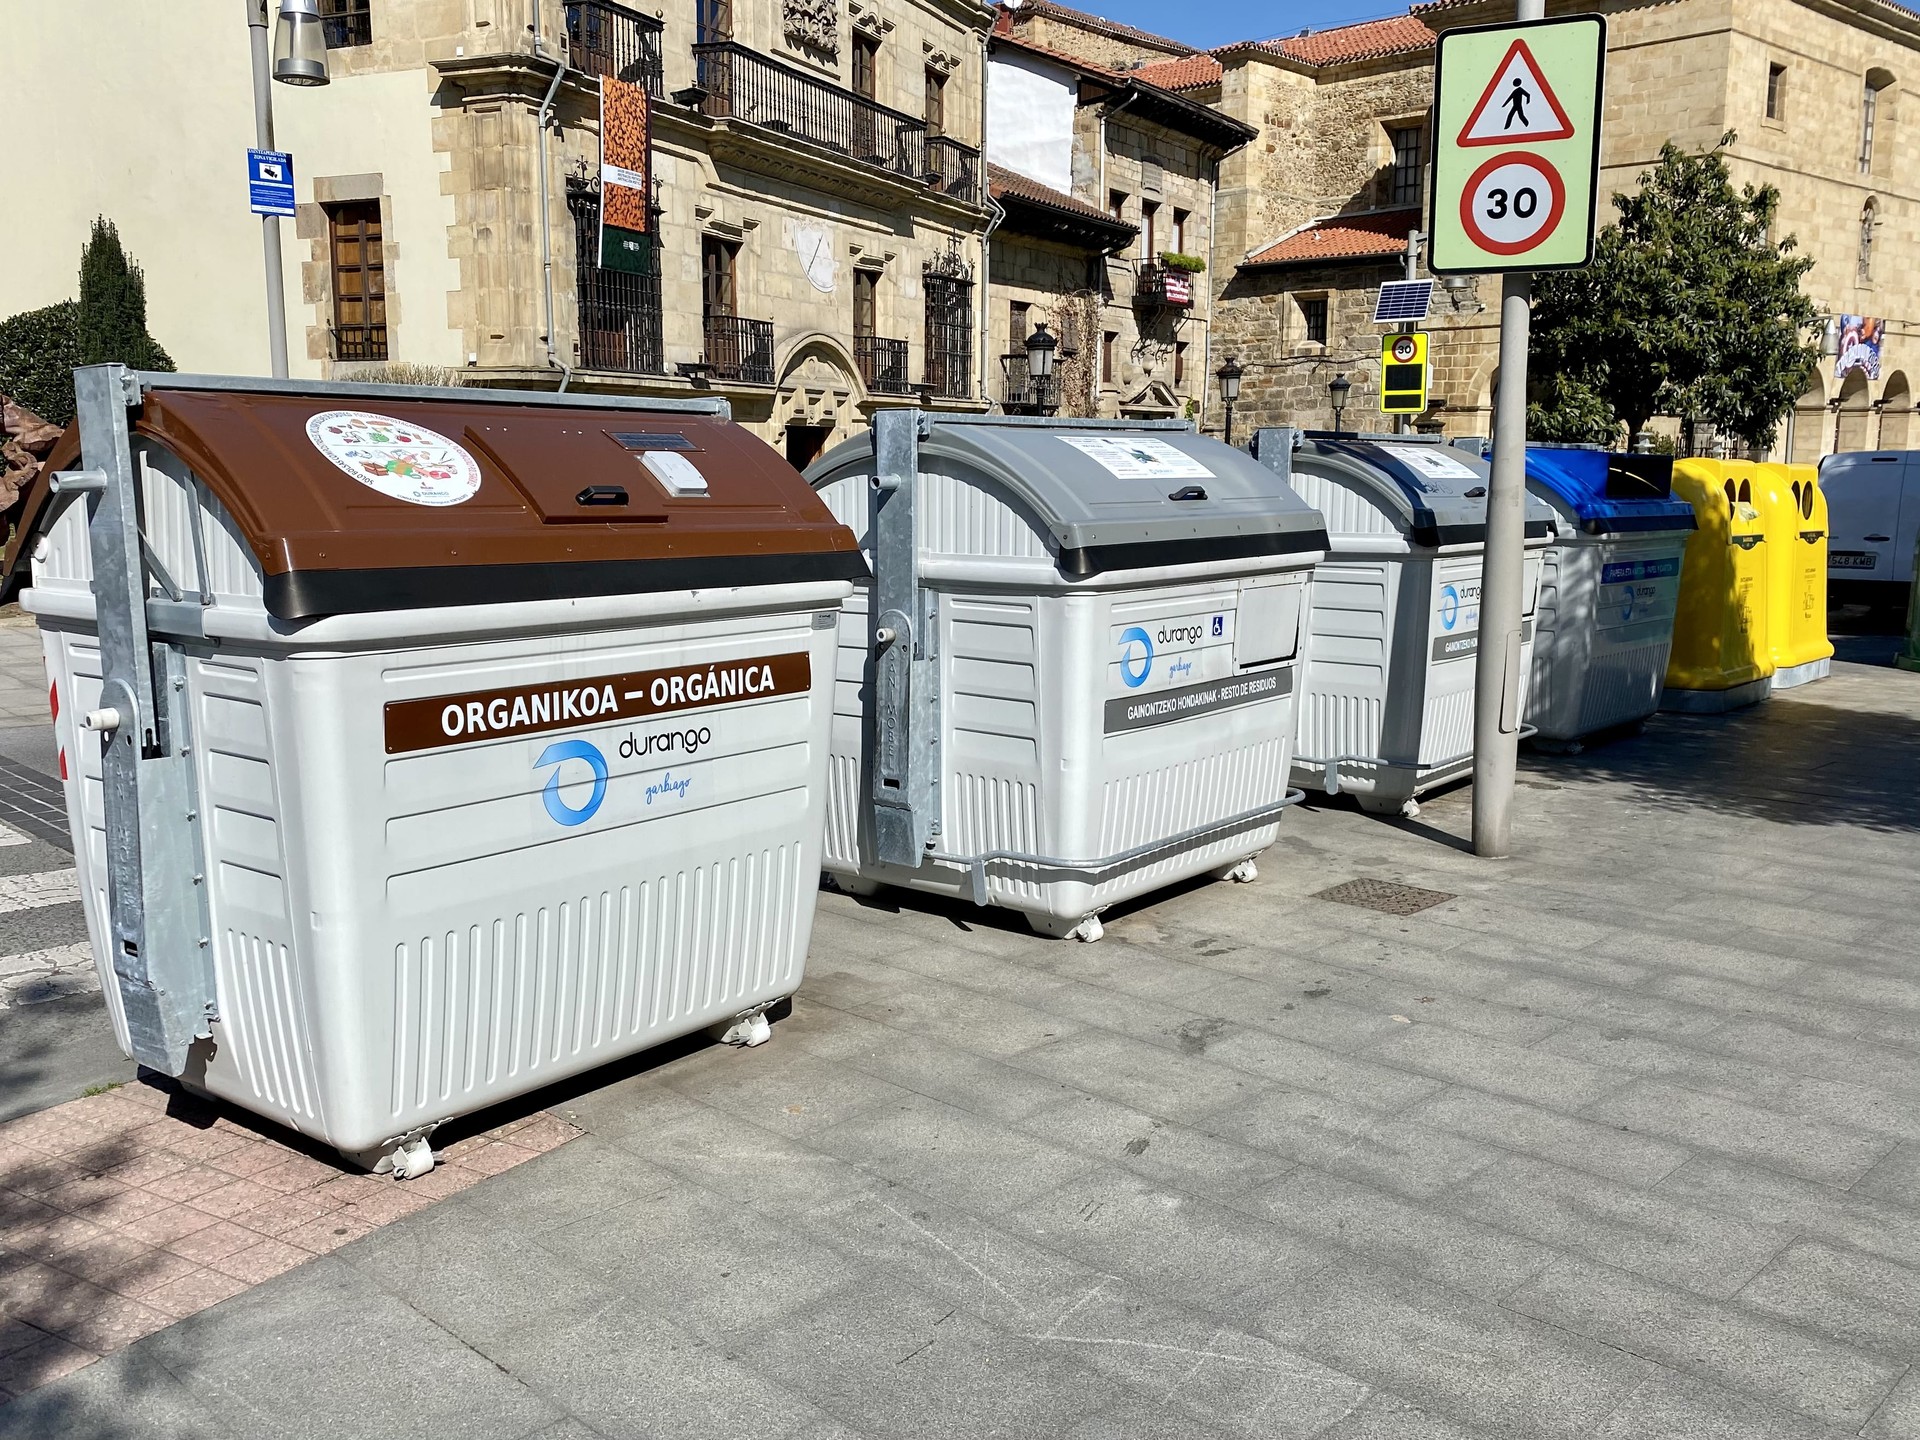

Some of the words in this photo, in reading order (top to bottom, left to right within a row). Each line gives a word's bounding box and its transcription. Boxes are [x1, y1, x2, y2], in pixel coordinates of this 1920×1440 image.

[1486, 187, 1538, 219] 30
[1397, 344, 1412, 355] 30
[1459, 585, 1481, 600] durang
[1636, 585, 1656, 597] durango
[1157, 624, 1203, 645] durango
[440, 684, 619, 737] ORGANIKOA
[649, 664, 775, 707] ORGÁNICA
[886, 649, 898, 771] SANIMOBEL
[1127, 698, 1177, 721] GAINONTZEKO
[1177, 689, 1218, 711] HONDAKINAK
[1221, 684, 1240, 701] RESTO
[1240, 682, 1249, 696] DE
[1249, 676, 1277, 695] RESIDUOS
[618, 726, 712, 759] durango
[644, 772, 692, 805] garbiago
